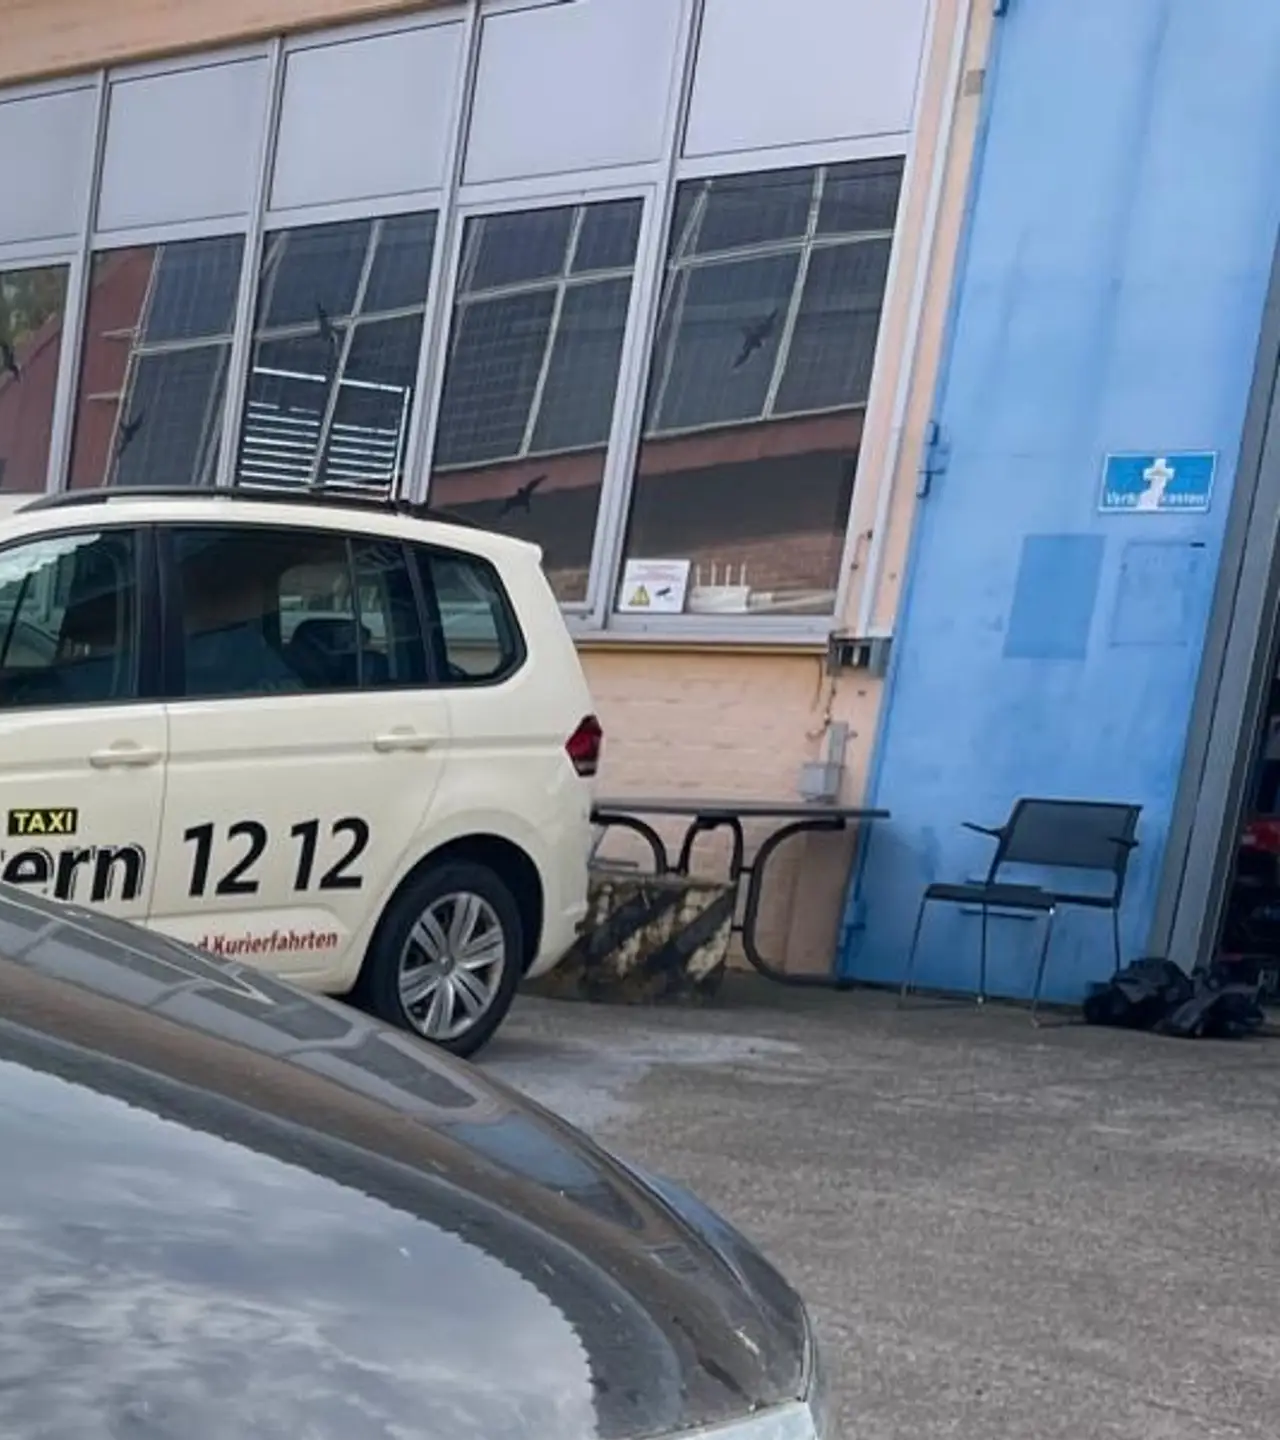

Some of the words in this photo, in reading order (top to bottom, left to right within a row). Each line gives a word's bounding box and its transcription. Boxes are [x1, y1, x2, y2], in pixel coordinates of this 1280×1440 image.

[13, 810, 74, 833] TAXI
[183, 820, 268, 897] 12
[290, 816, 370, 892] 12
[213, 929, 339, 955] Kurierfahrten
